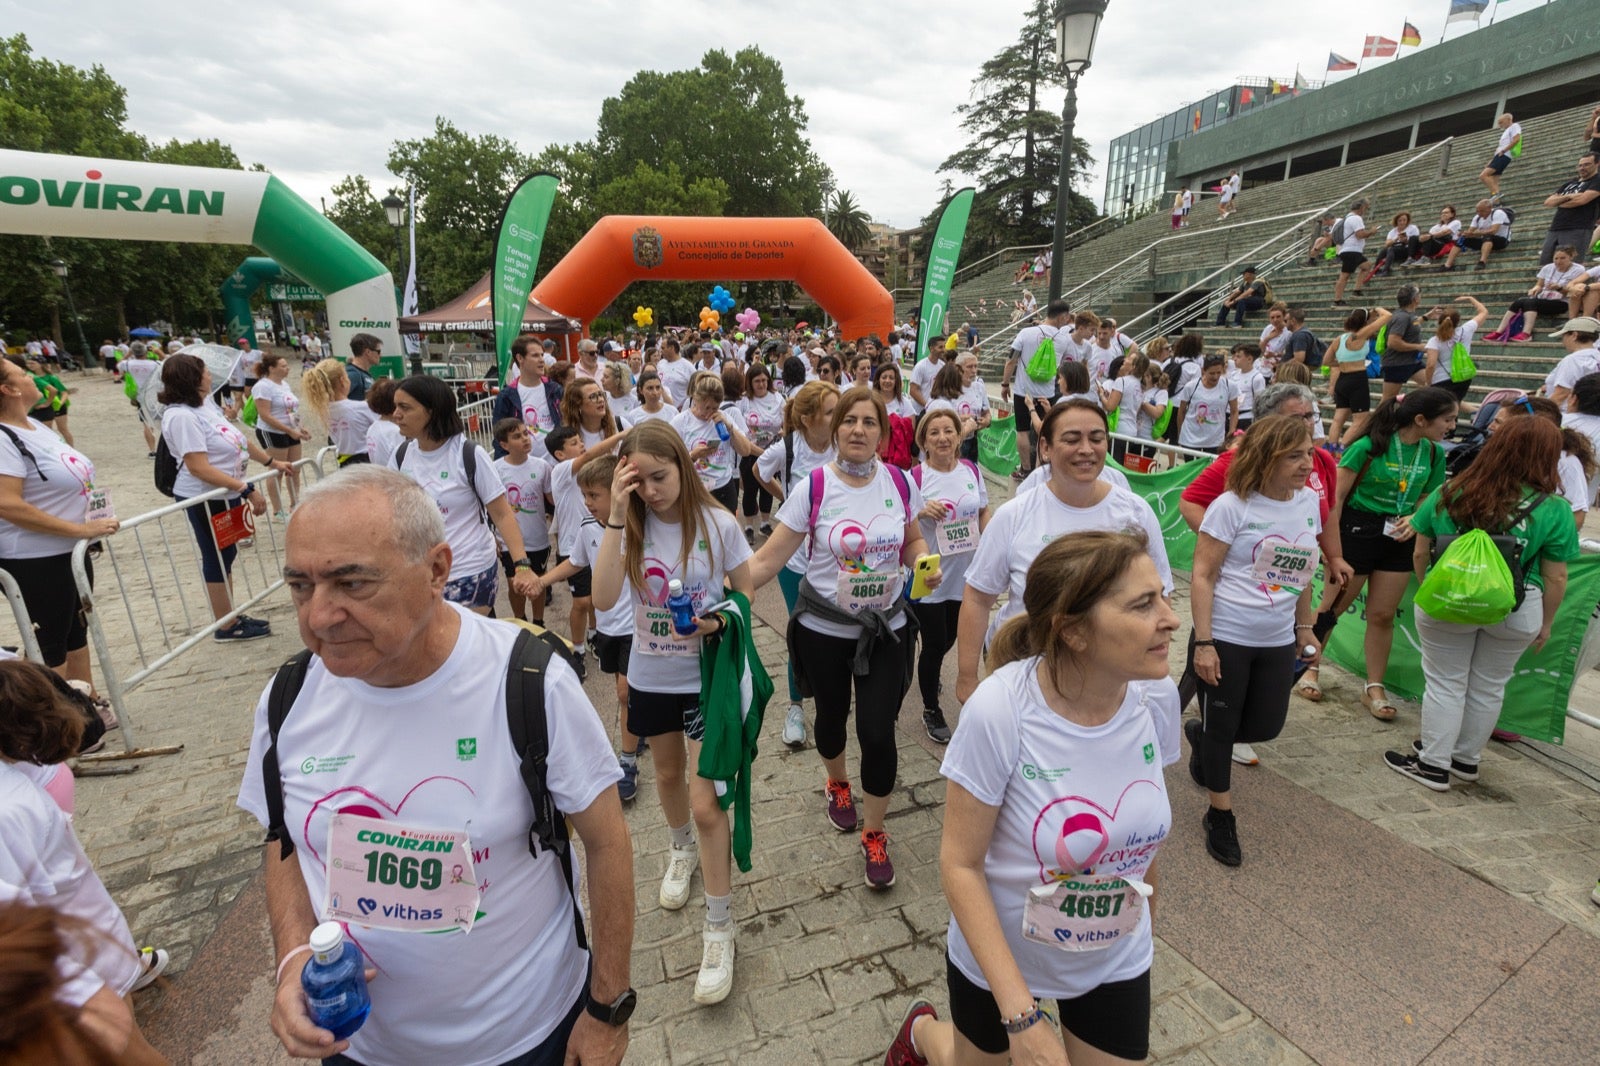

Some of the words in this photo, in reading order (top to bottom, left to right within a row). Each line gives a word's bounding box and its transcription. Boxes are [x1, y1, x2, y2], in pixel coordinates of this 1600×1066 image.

[668, 240, 737, 249] AYUNTAMIENTO
[752, 240, 794, 249] GRANADA
[730, 250, 743, 260] de
[745, 250, 784, 261] Deportes
[339, 318, 391, 329] COVIRAN
[946, 527, 970, 541] 5293
[1274, 546, 1313, 557] COVIRAN
[1271, 554, 1307, 571] 2269
[849, 575, 887, 584] COVIRAN
[1277, 573, 1300, 583] vithas
[851, 584, 884, 598] 4864
[646, 609, 672, 619] COVI
[650, 621, 672, 637] 48
[659, 643, 688, 651] vithas
[357, 830, 454, 853] COVIRAN
[408, 831, 455, 841] Fundación
[1125, 832, 1142, 847] Un
[364, 850, 443, 890] 1669
[382, 903, 443, 921] vithas
[1059, 893, 1126, 918] 4697
[1076, 929, 1120, 942] vithas
